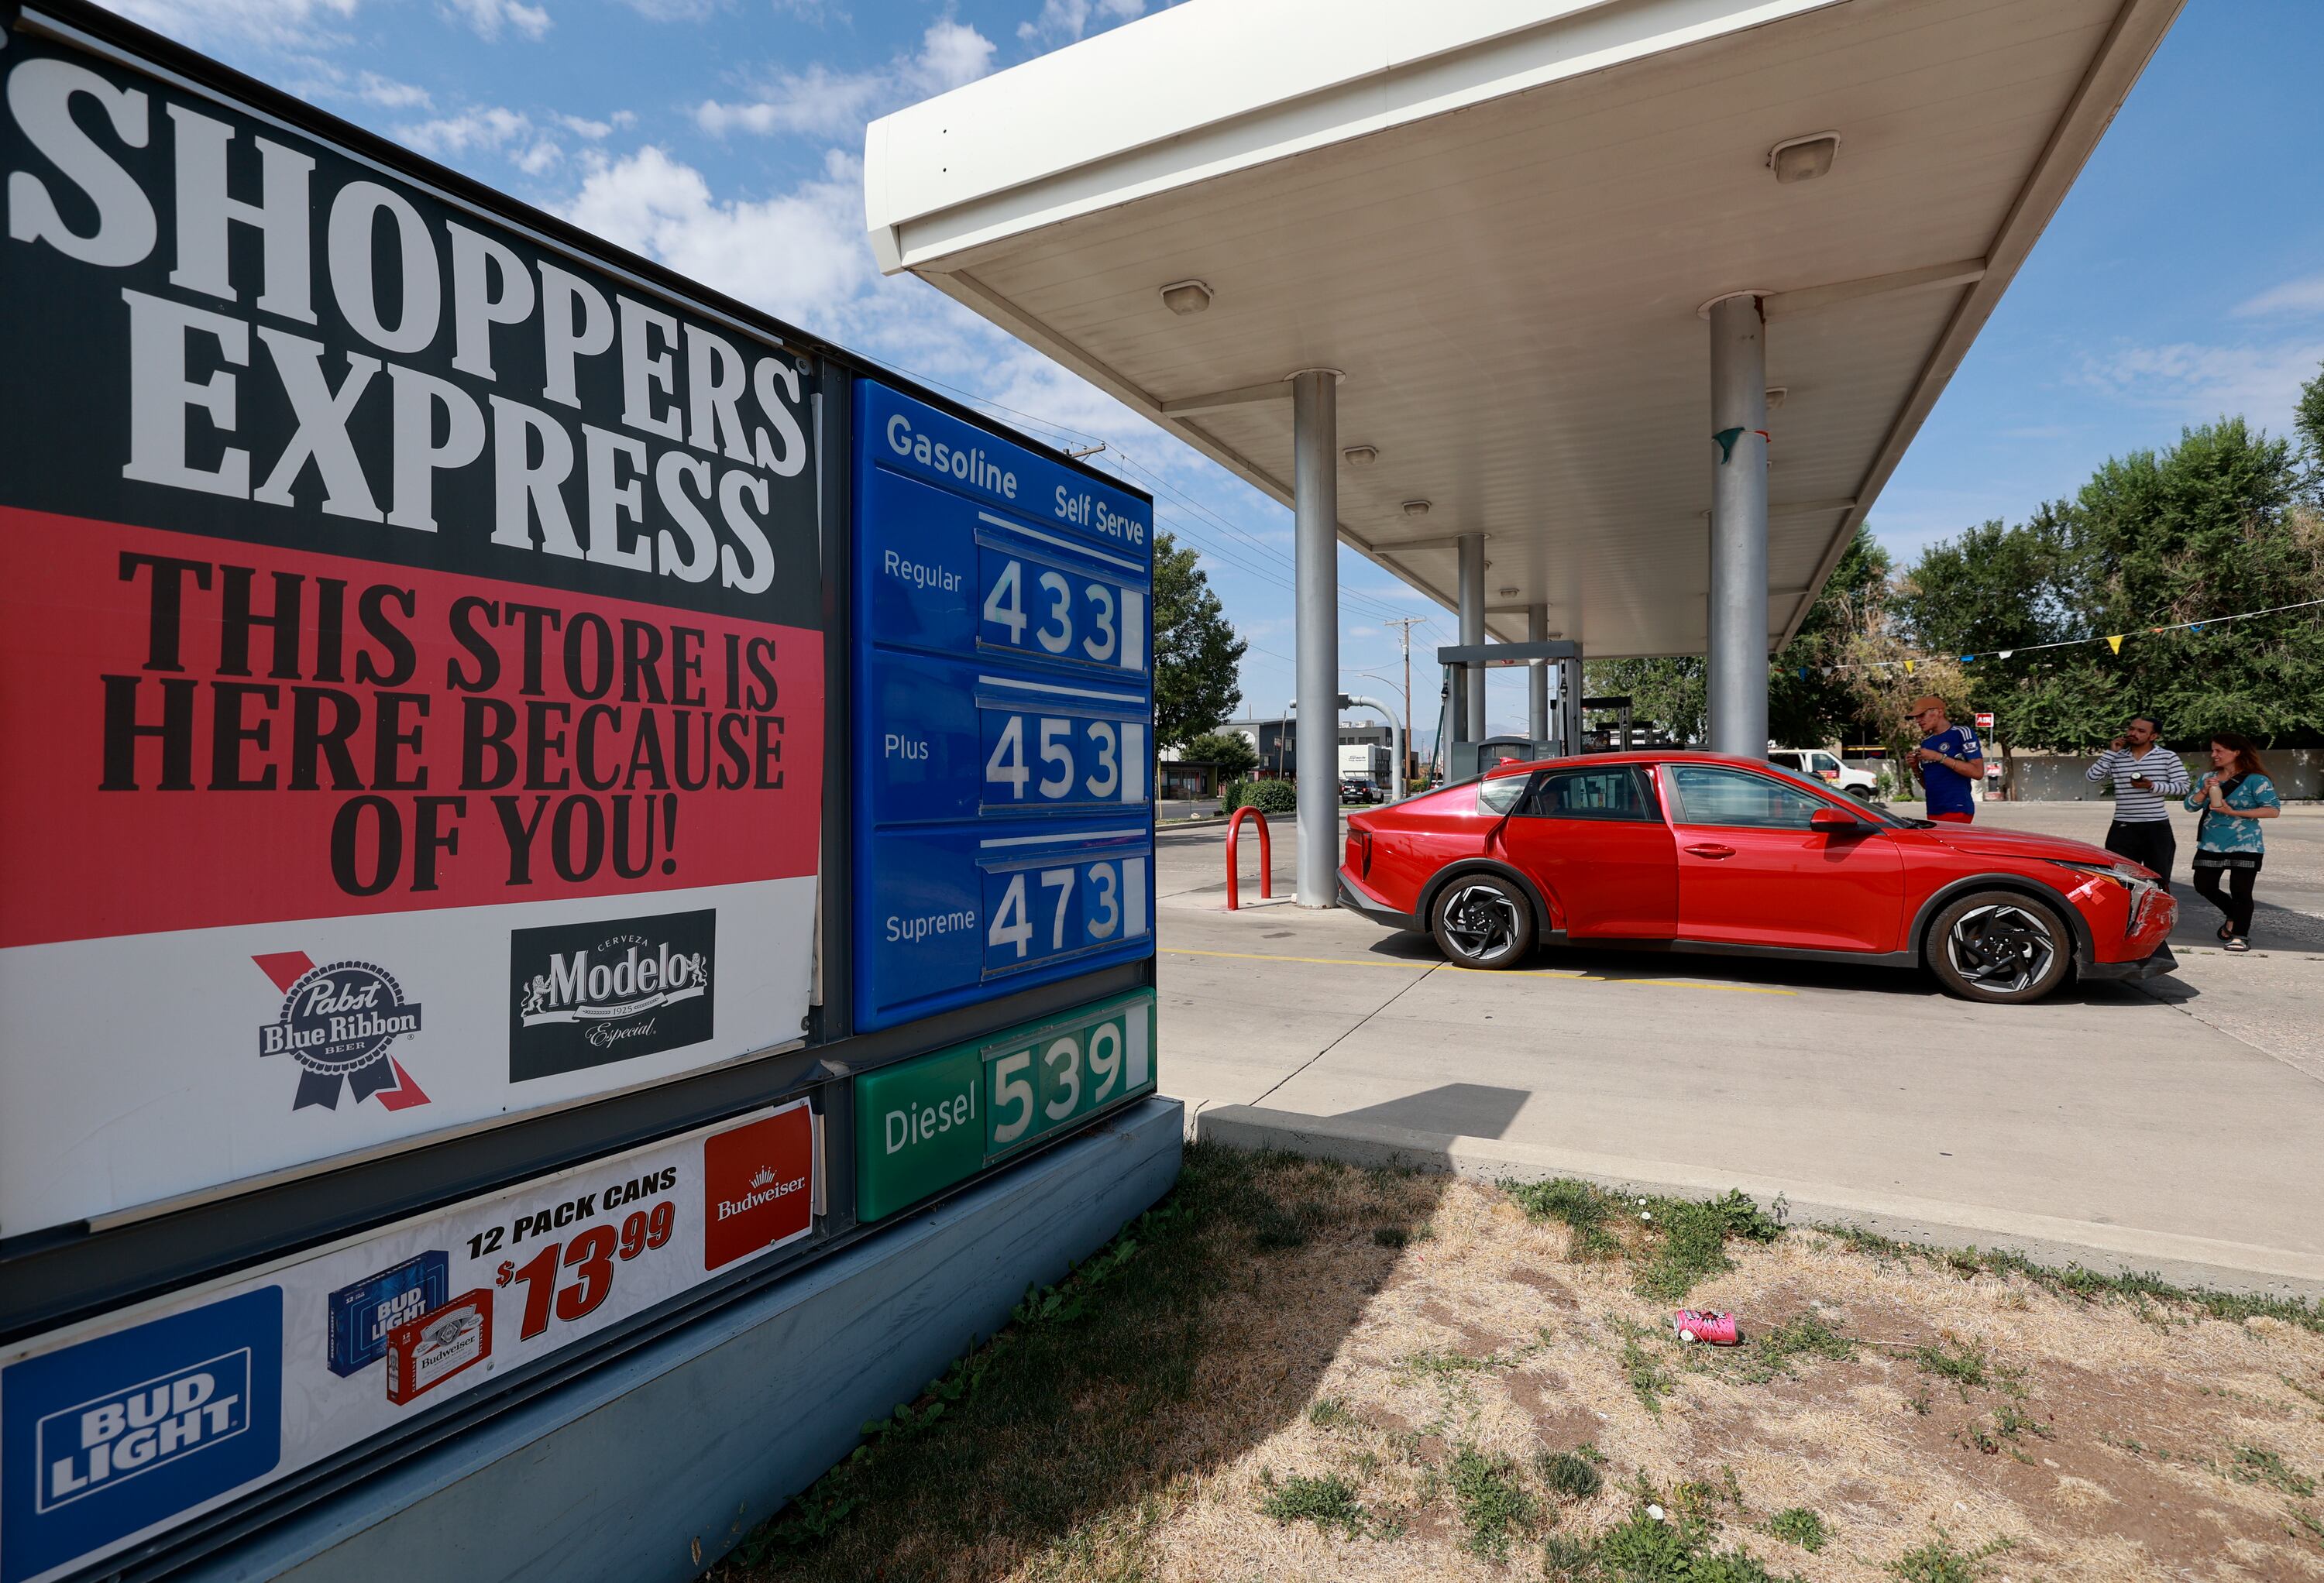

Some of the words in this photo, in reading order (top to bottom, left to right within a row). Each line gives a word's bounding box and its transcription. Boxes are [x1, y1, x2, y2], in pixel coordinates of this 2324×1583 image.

[6, 58, 806, 477] SHOPPERS
[121, 287, 775, 594] EXPRESS
[887, 414, 1017, 500] Gasoline
[1054, 485, 1091, 527] Self
[1095, 500, 1143, 545] Serve
[119, 550, 417, 688] THIS
[445, 596, 706, 708] STORE
[724, 633, 778, 713] IS
[885, 549, 961, 592] Regular
[983, 559, 1116, 661] 433
[98, 675, 430, 792] HERE
[459, 695, 784, 792] BECAUSE
[885, 734, 929, 760] Plus
[985, 716, 1119, 799] 453
[330, 793, 465, 898] OF
[490, 792, 679, 886] YOU!
[597, 935, 648, 953] CERVEZA
[885, 910, 975, 943] Supreme
[988, 862, 1119, 958] 473
[302, 980, 382, 1017] Pabst
[548, 942, 689, 1008] Modelo
[613, 1005, 633, 1015] 1925
[263, 1024, 325, 1054] Blue
[329, 1011, 417, 1043] Ribbon
[325, 1042, 365, 1054] BEER
[585, 1018, 655, 1048] Especial
[885, 1080, 975, 1155] Diesel
[994, 1022, 1122, 1143] 539
[466, 1227, 505, 1260] 12
[512, 1193, 597, 1245] PACK
[603, 1166, 676, 1210] CANS
[717, 1176, 805, 1221] Budweiser
[372, 1300, 426, 1341] LIGHT
[377, 1287, 421, 1322] BUD
[421, 1335, 475, 1369] Budweiser
[52, 1394, 239, 1499] LIGHT
[81, 1372, 215, 1450] BUD
